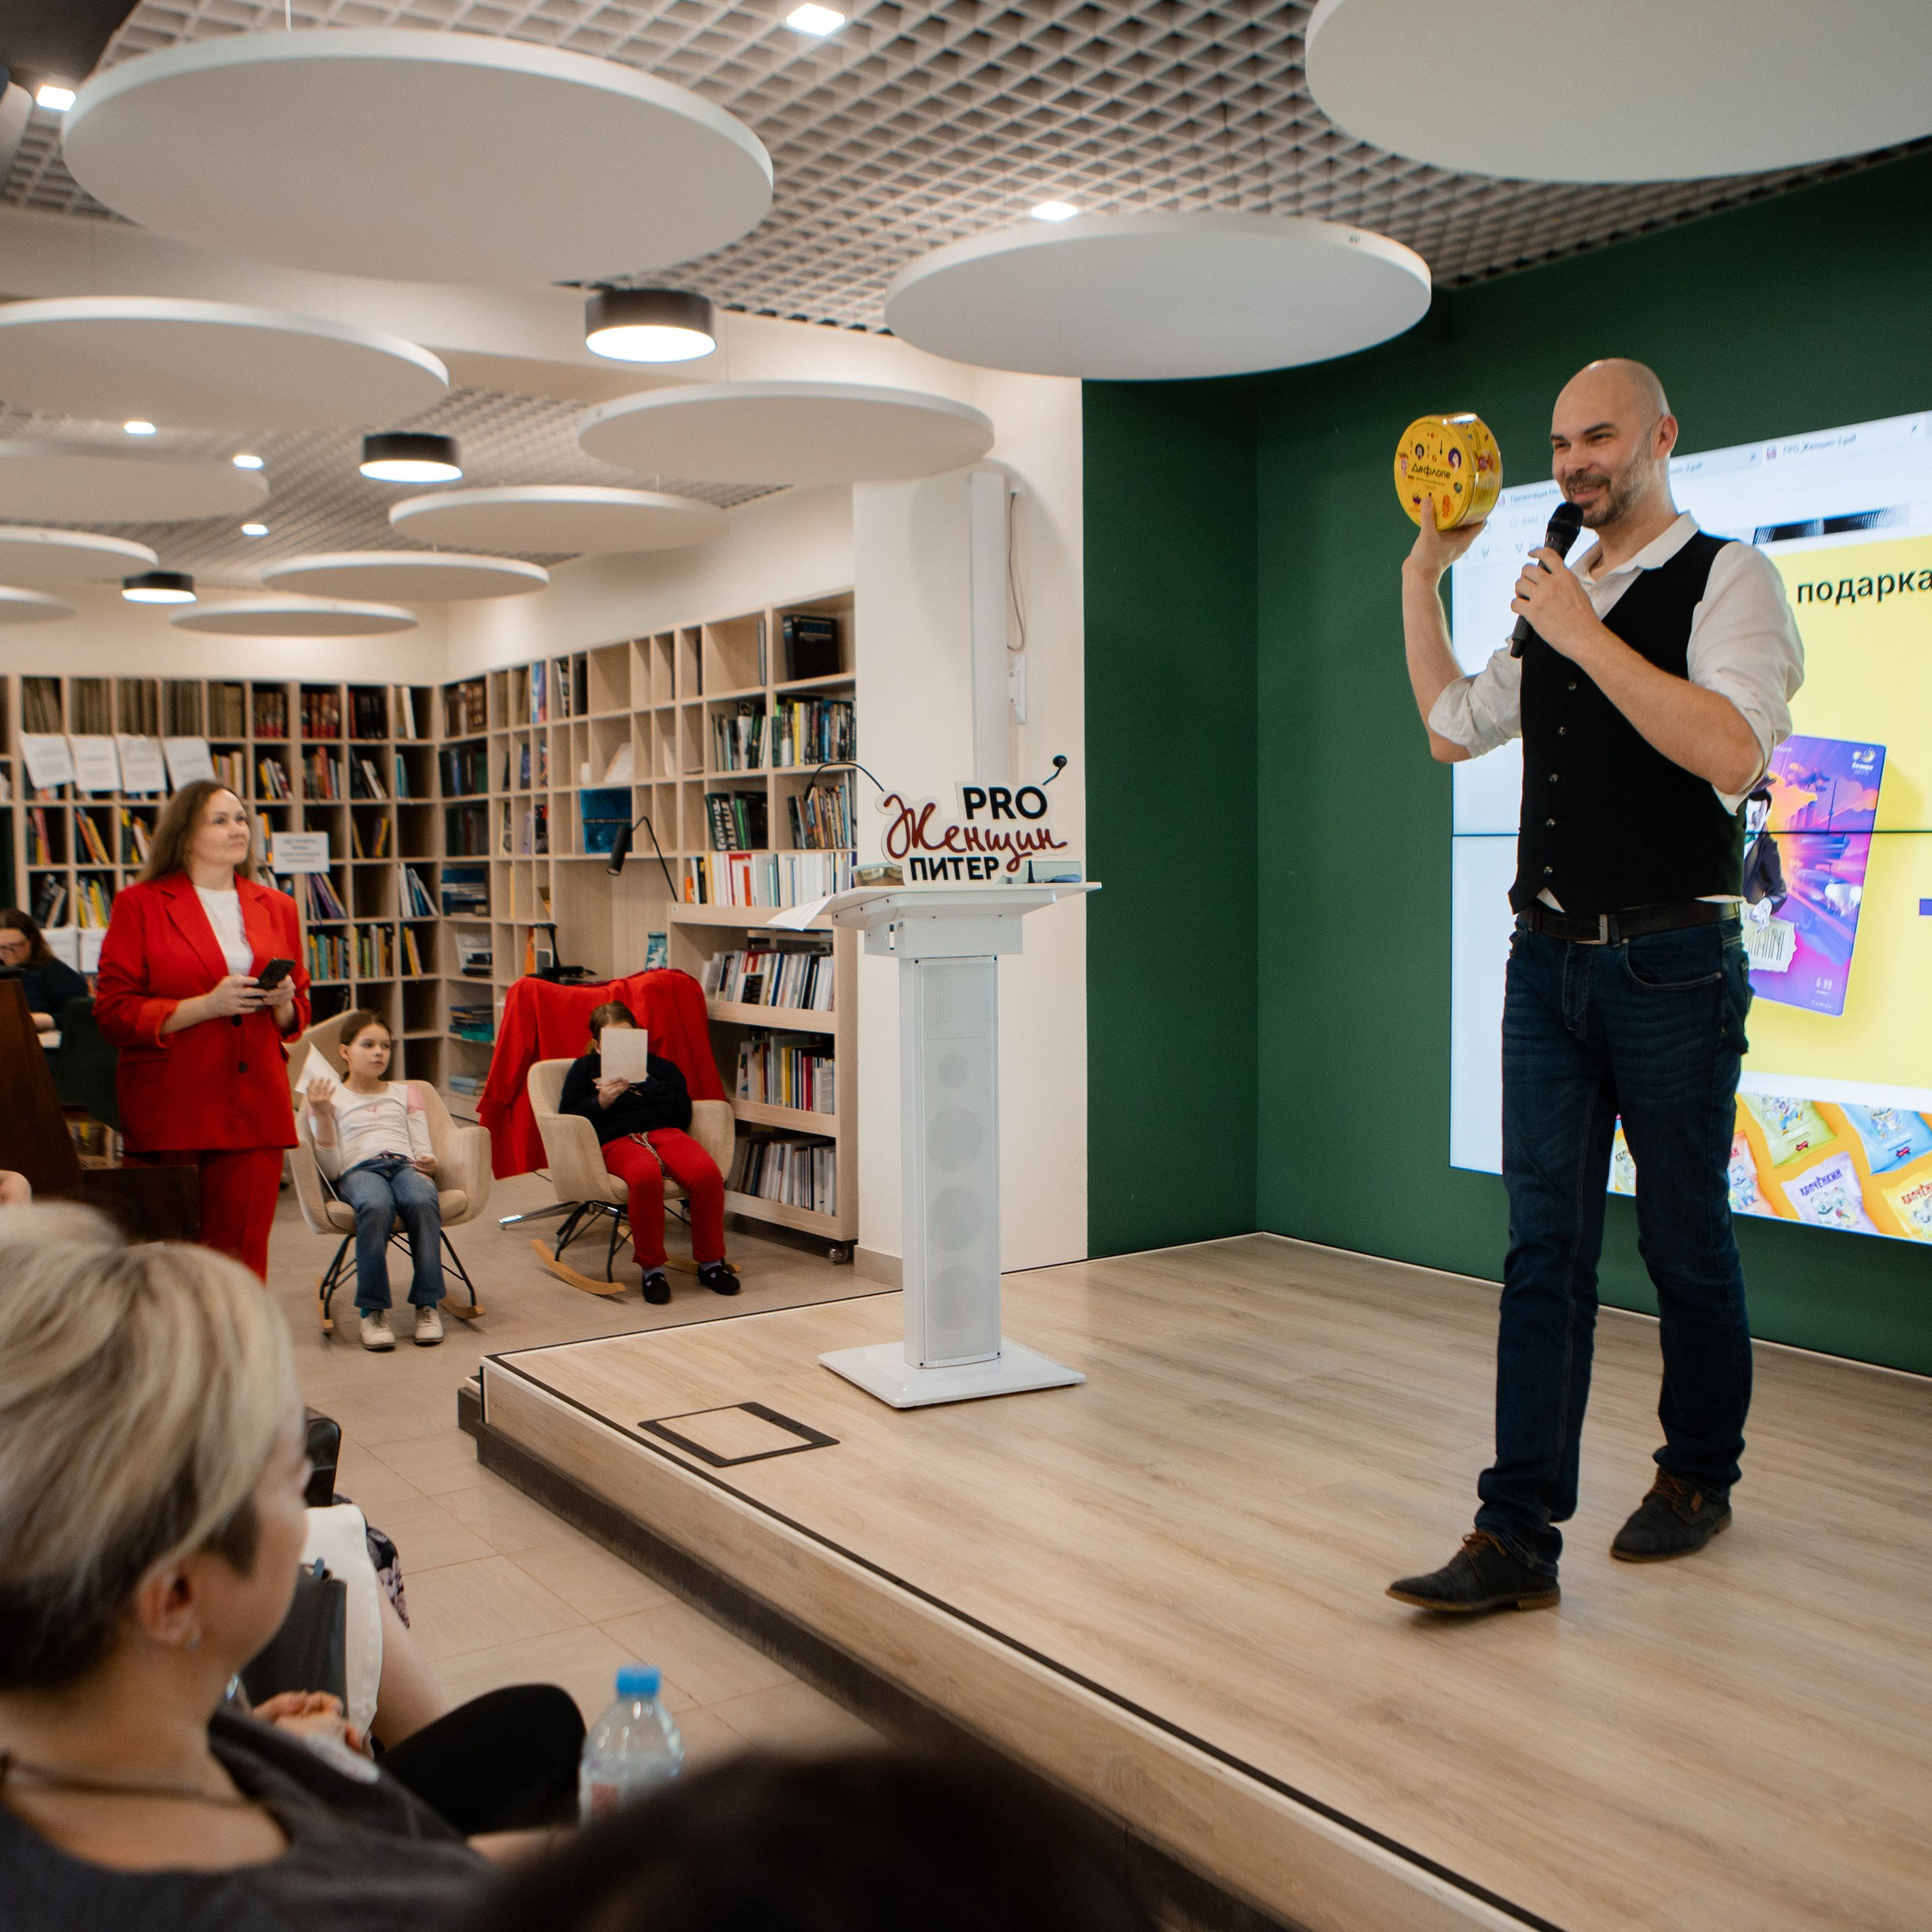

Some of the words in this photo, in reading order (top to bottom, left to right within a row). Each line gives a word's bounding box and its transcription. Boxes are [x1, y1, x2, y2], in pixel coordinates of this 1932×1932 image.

[1411, 463, 1451, 479] Дефлопе
[1798, 569, 1932, 606] подарка
[962, 786, 1048, 820] PRO
[883, 794, 1068, 872] Женщин
[909, 857, 999, 881] ПИТЕР
